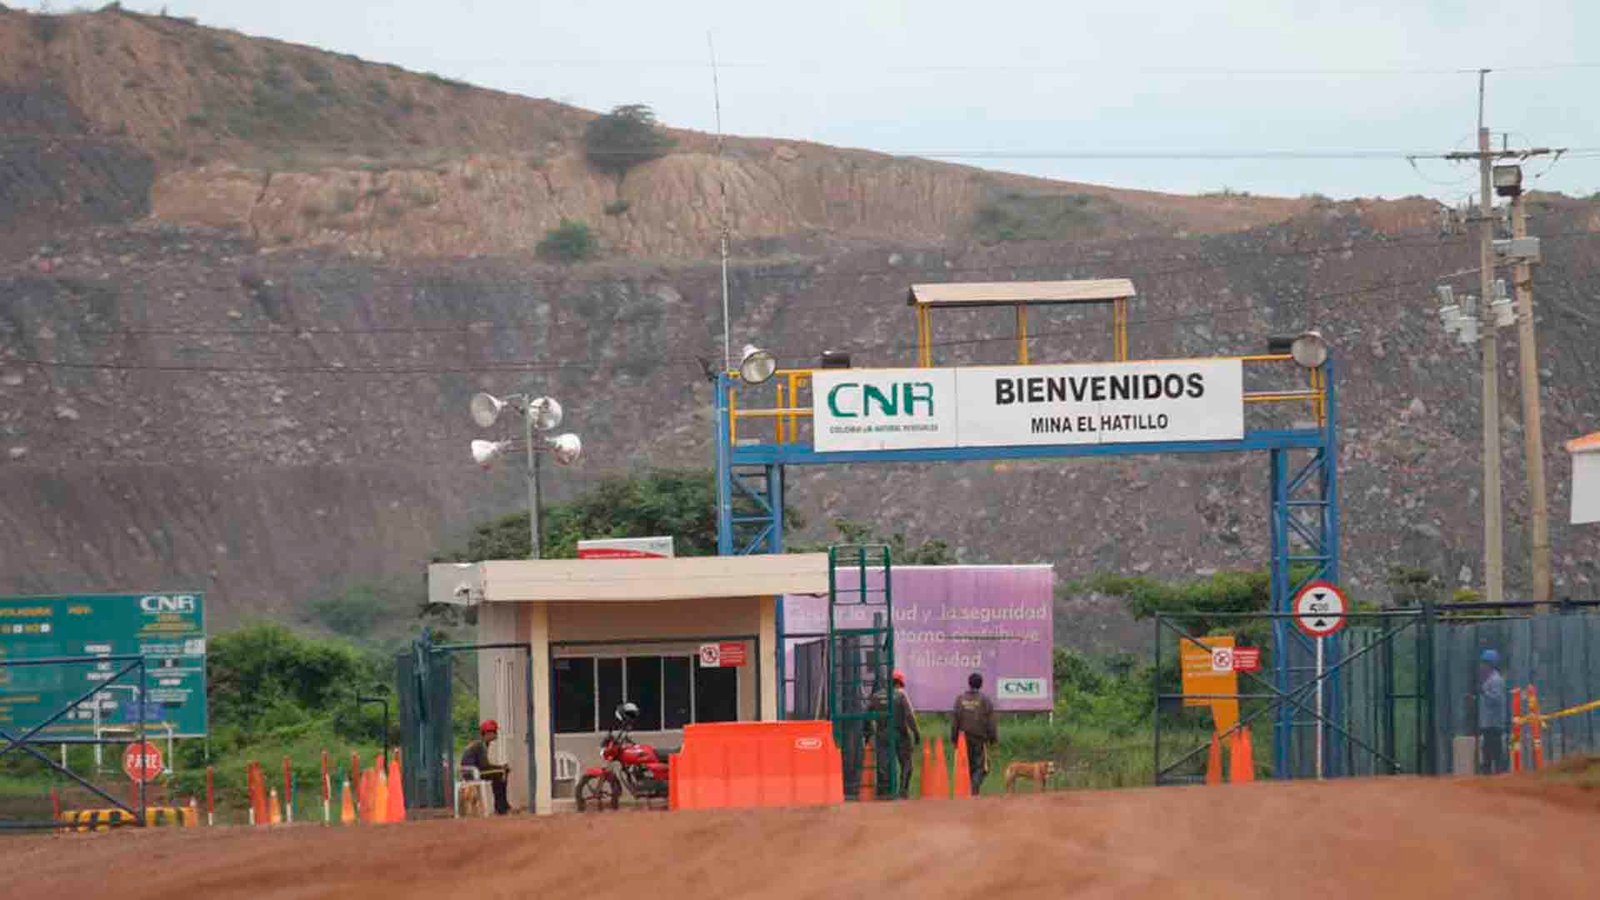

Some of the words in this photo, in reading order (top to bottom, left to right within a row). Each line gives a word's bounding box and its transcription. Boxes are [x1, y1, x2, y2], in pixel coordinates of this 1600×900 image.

[828, 382, 934, 417] CNR
[996, 373, 1204, 405] BIENVENIDOS
[1031, 417, 1073, 433] MINA
[1077, 416, 1097, 432] EL
[1100, 413, 1168, 431] HATILLO
[141, 596, 194, 611] CNR
